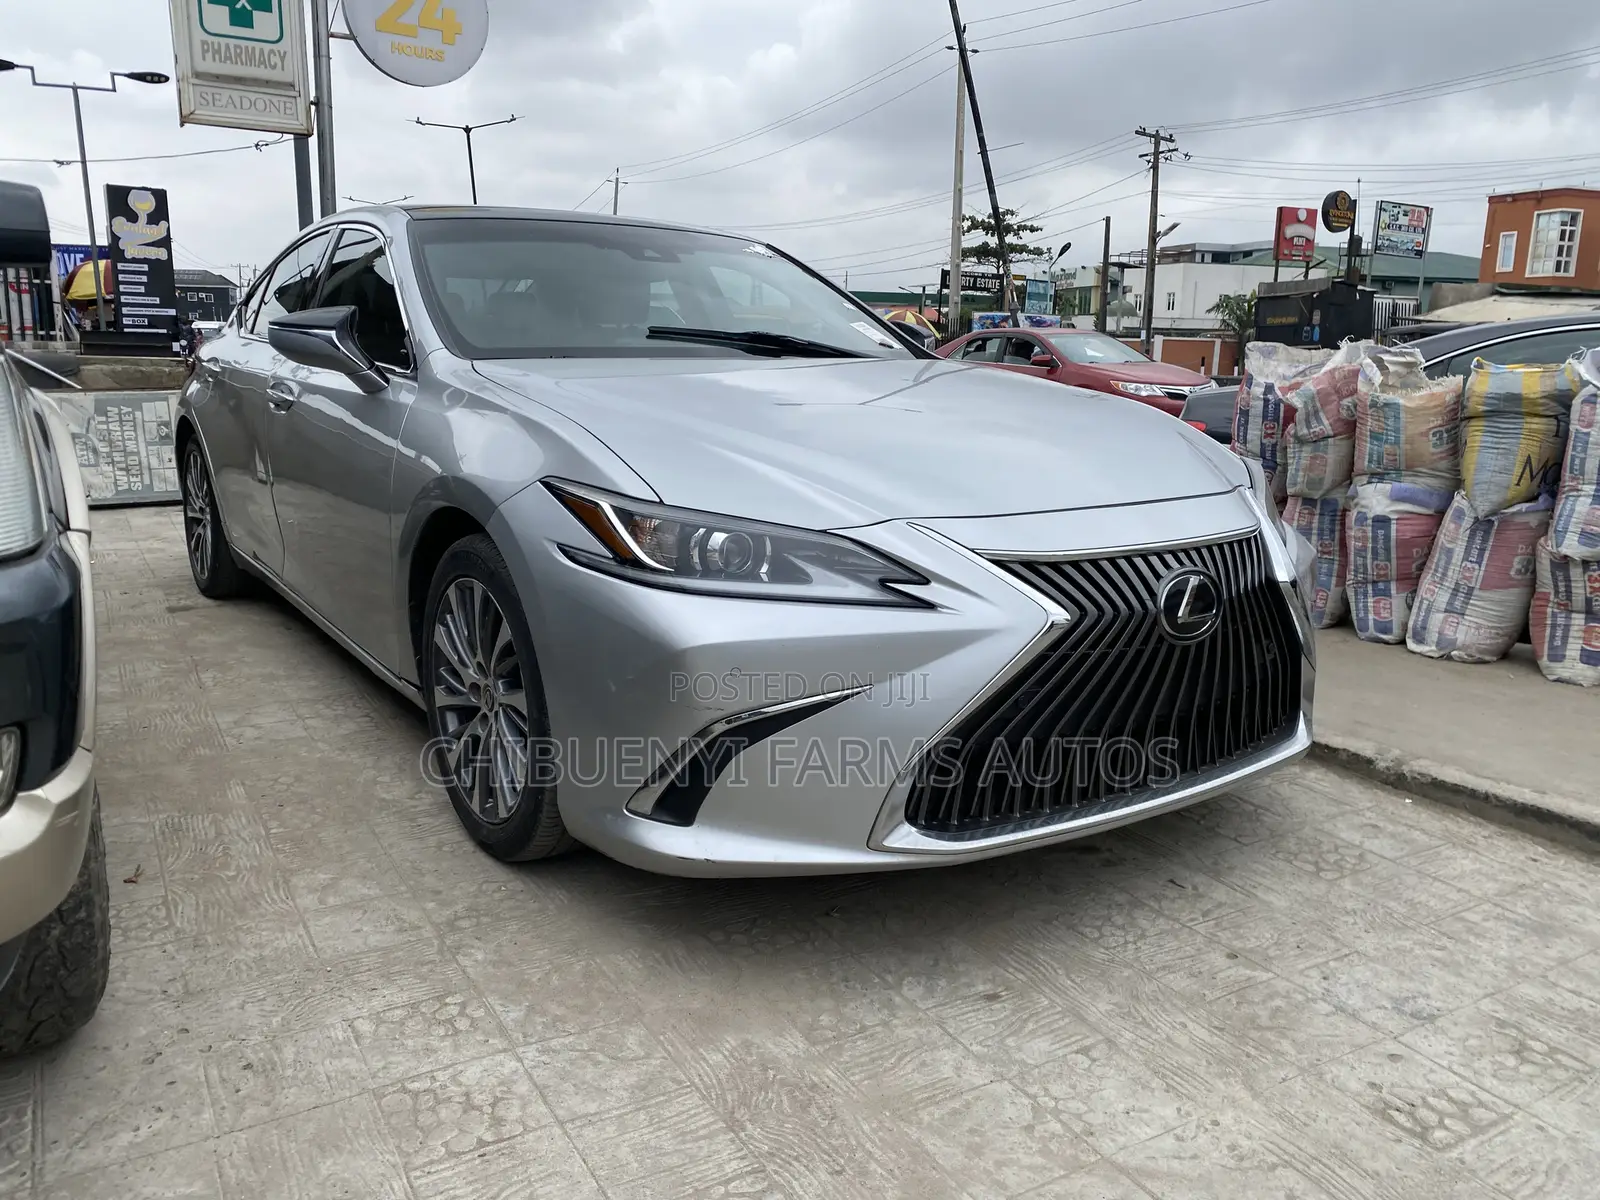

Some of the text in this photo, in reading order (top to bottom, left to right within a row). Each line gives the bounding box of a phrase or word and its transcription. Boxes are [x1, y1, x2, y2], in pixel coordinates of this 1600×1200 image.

[375, 0, 463, 45] 24
[200, 39, 288, 72] PHARMACY
[390, 41, 446, 62] HOURS
[198, 91, 295, 116] SEADONE
[946, 275, 975, 287] LRTY
[976, 277, 1001, 289] ESTATE
[1263, 422, 1277, 441] 3X
[75, 437, 88, 465] ATM
[94, 413, 115, 483] DEPOSIT
[107, 406, 129, 491] WITHDRAW
[120, 405, 142, 491] SEND MONEY
